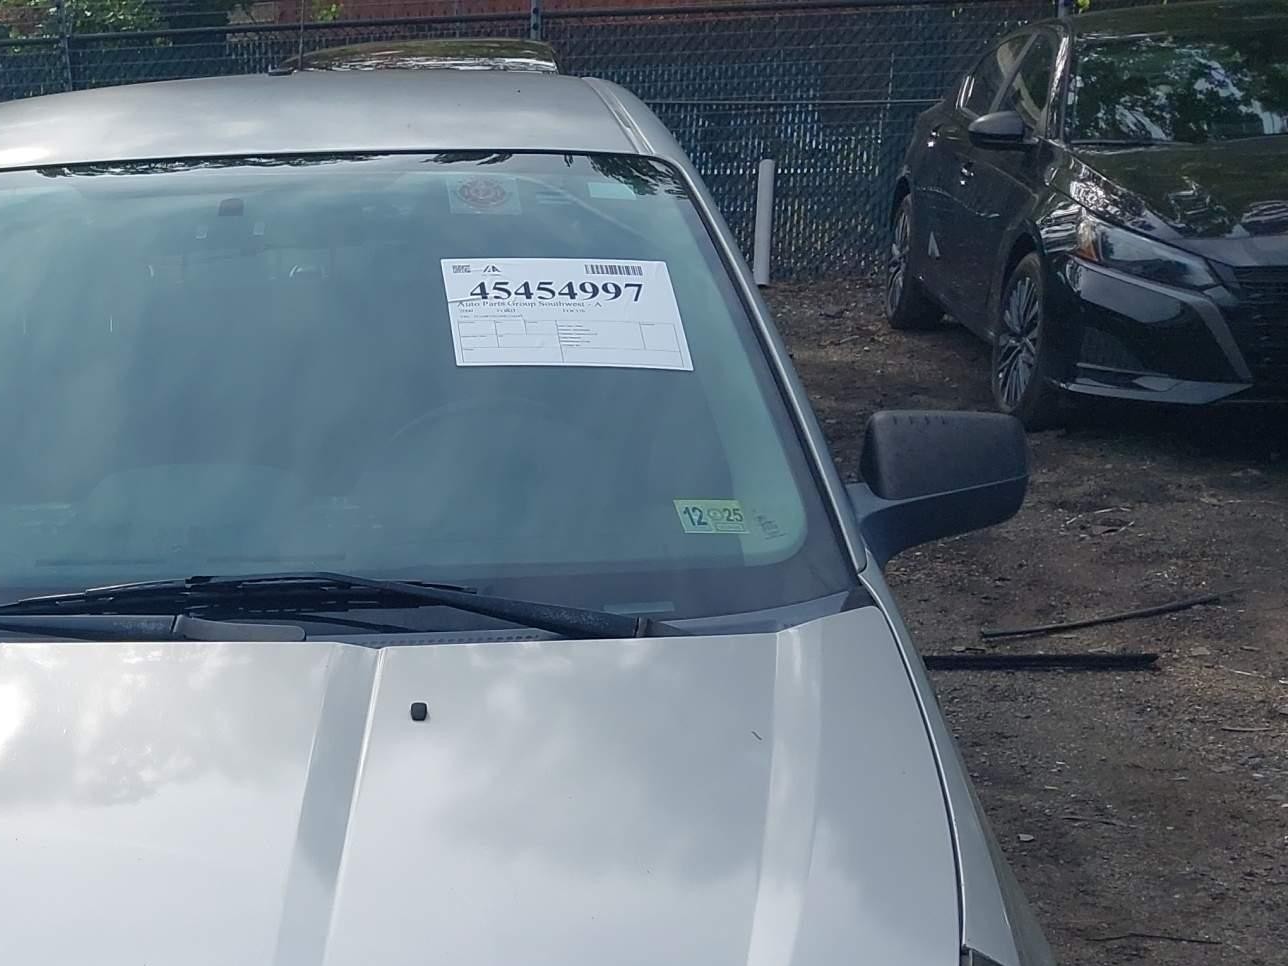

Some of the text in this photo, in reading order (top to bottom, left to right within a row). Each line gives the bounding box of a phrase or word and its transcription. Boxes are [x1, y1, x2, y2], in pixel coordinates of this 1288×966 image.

[470, 281, 643, 302] 45454997
[507, 301, 536, 309] Group
[683, 506, 744, 526] 12 25
